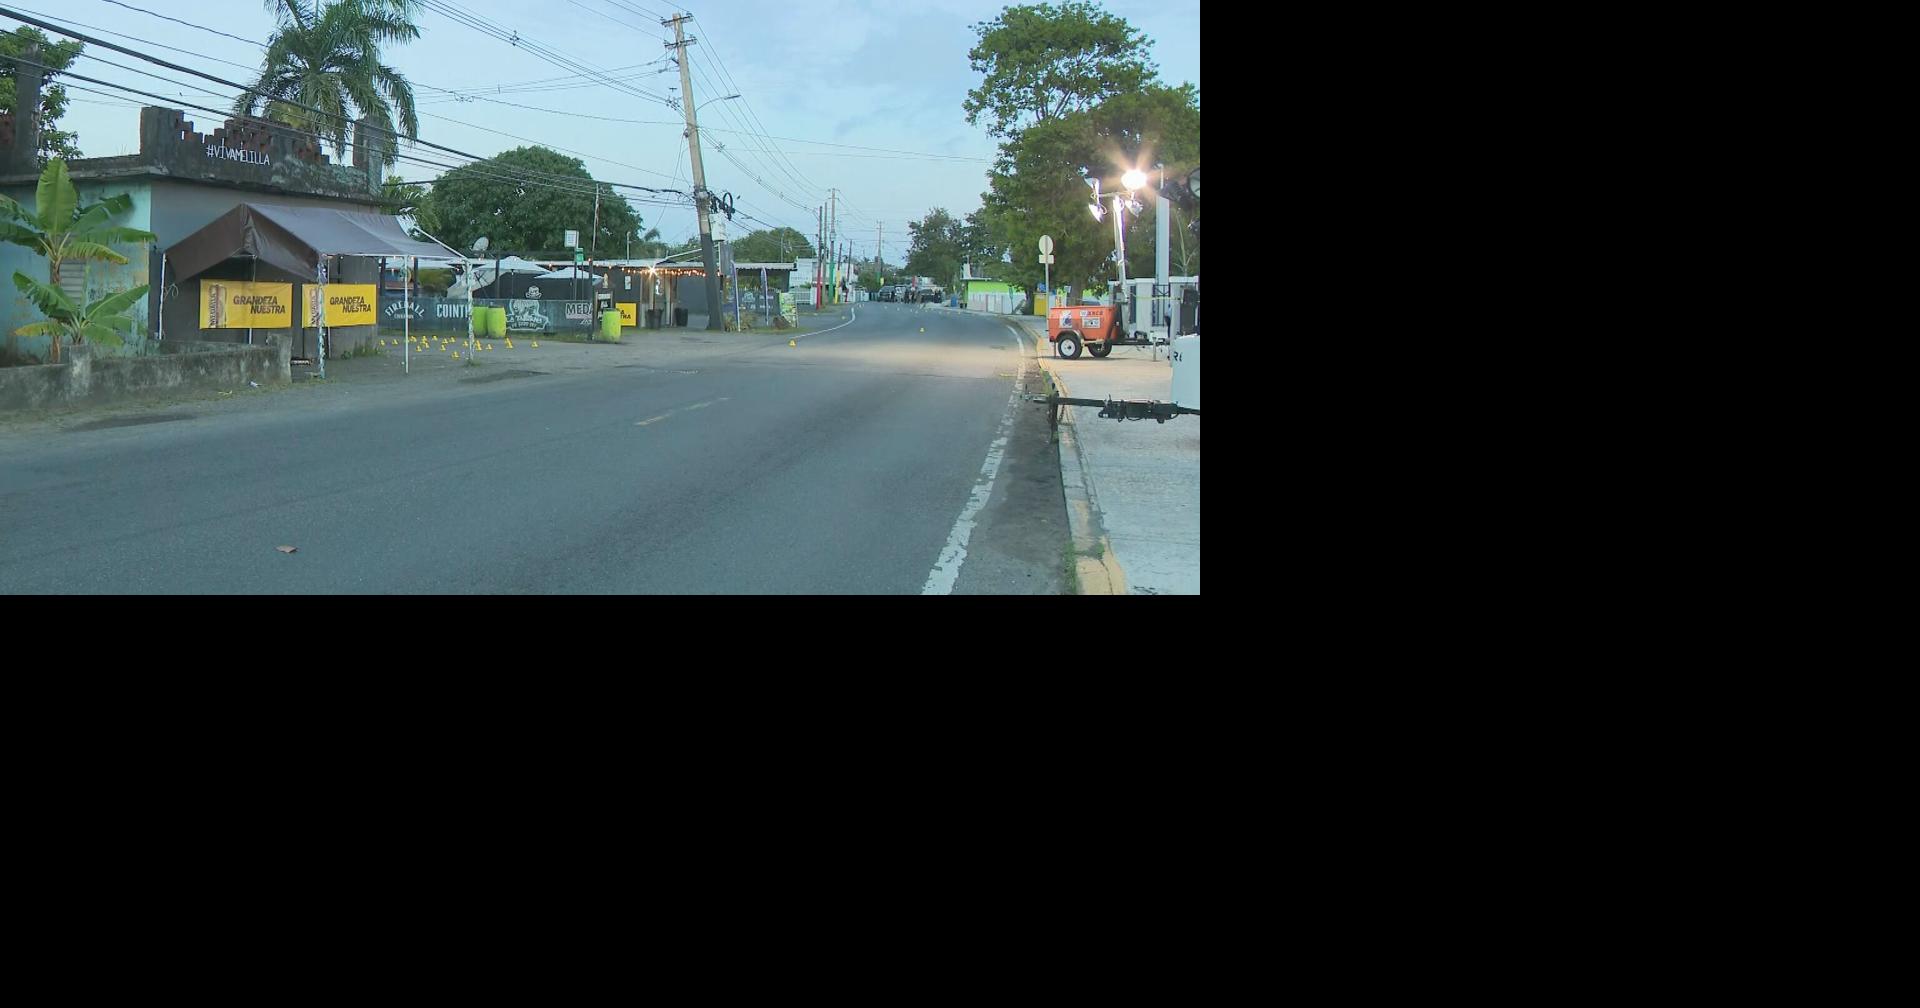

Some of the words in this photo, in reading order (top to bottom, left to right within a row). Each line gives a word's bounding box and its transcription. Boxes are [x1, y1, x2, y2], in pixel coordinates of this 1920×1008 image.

[233, 295, 278, 305] GRANDEZA
[329, 296, 365, 305] GRANDEZA
[250, 305, 286, 314] NUESTRA
[342, 304, 371, 313] NUESTRA
